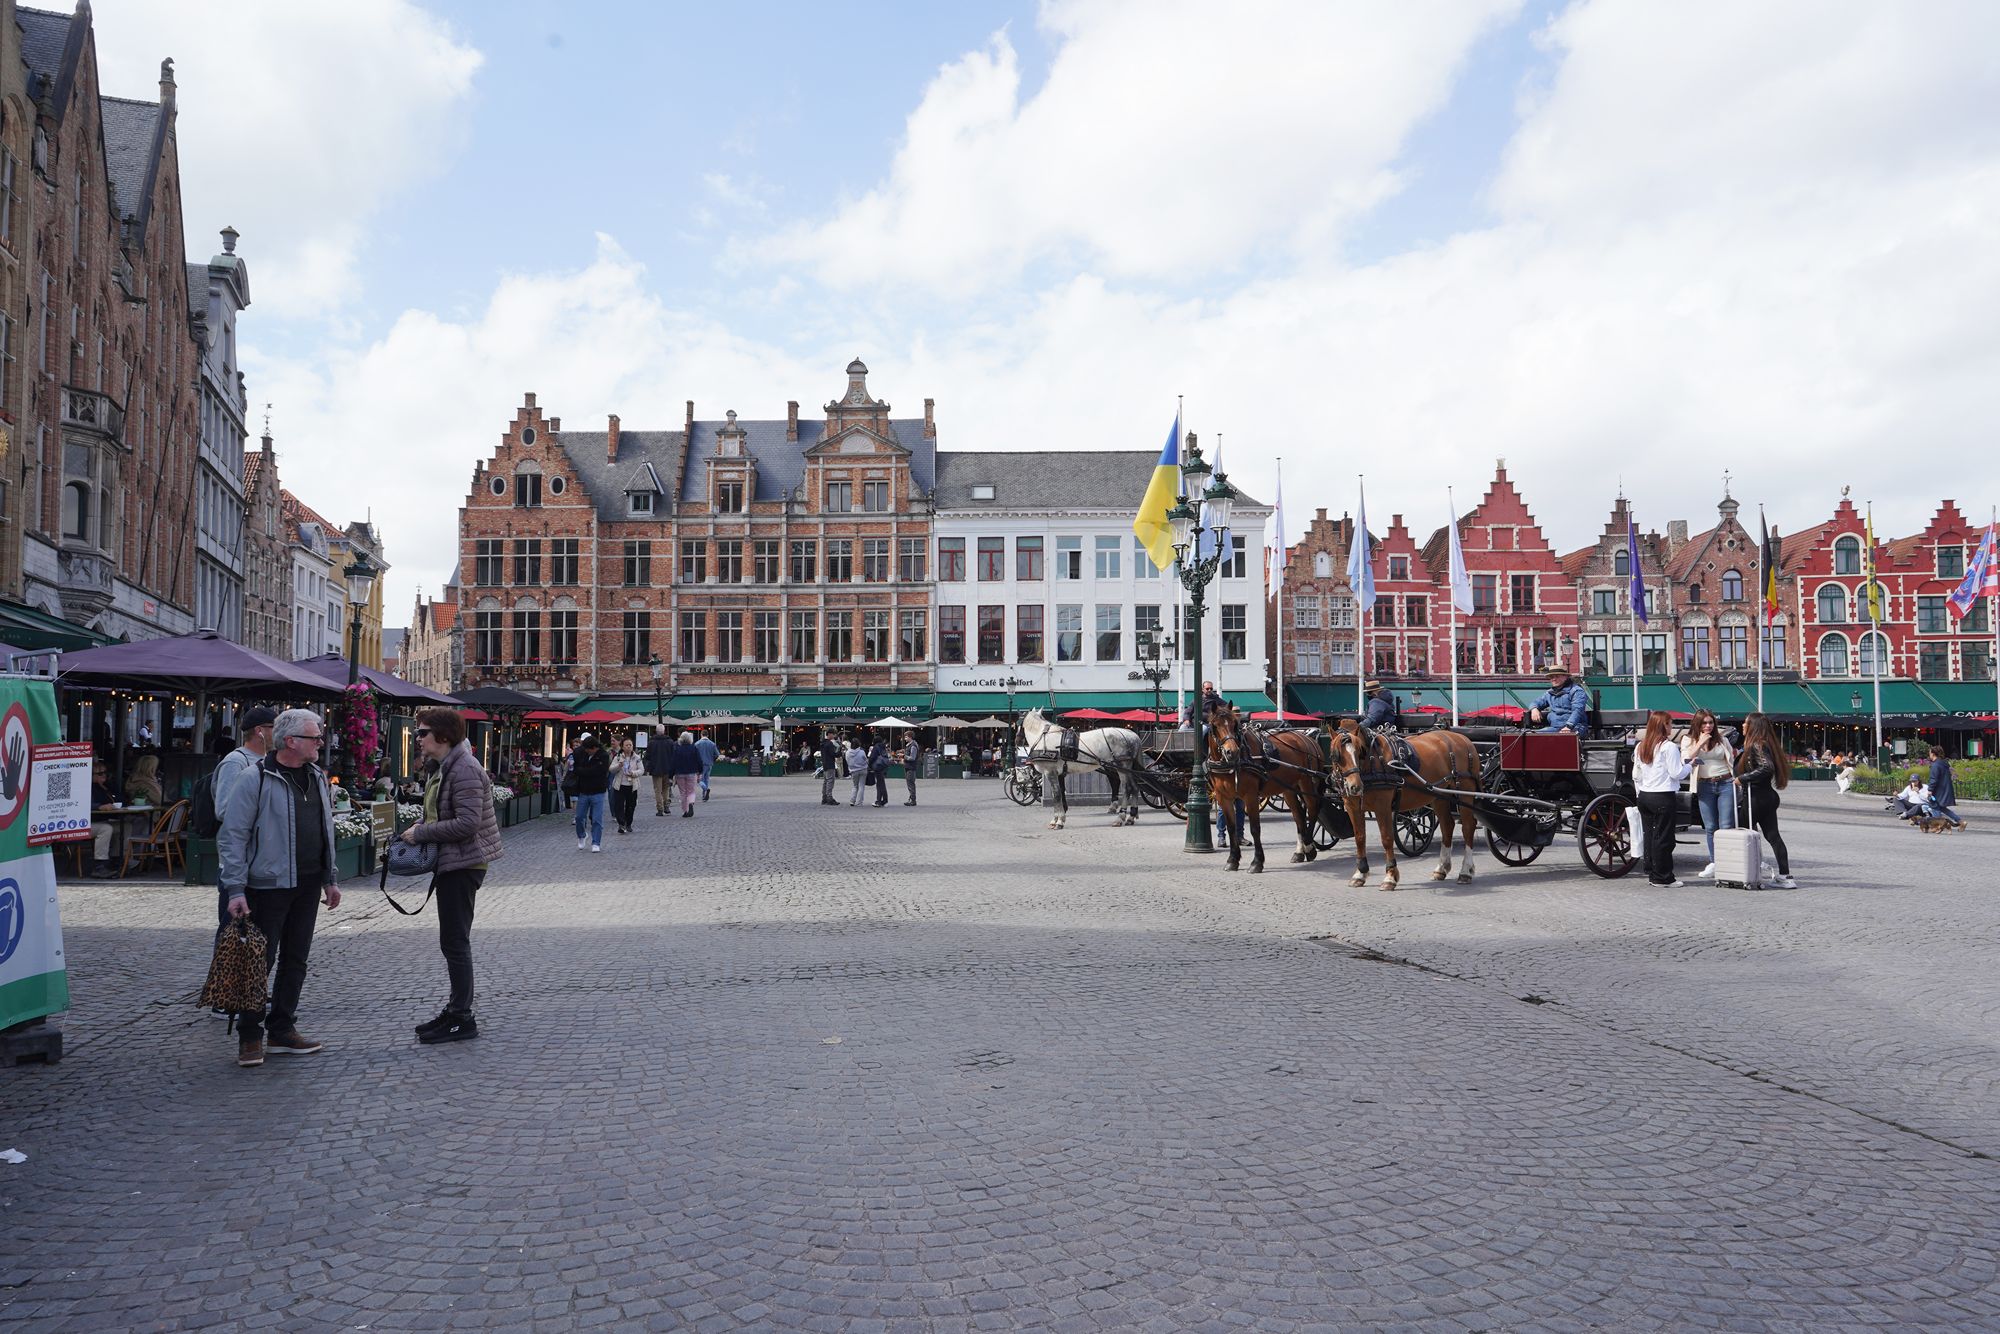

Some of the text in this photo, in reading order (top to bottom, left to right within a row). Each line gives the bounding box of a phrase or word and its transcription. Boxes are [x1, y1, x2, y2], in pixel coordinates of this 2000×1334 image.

[493, 666, 558, 675] DE BEURZE
[952, 679, 1033, 687] Grand Café lfort
